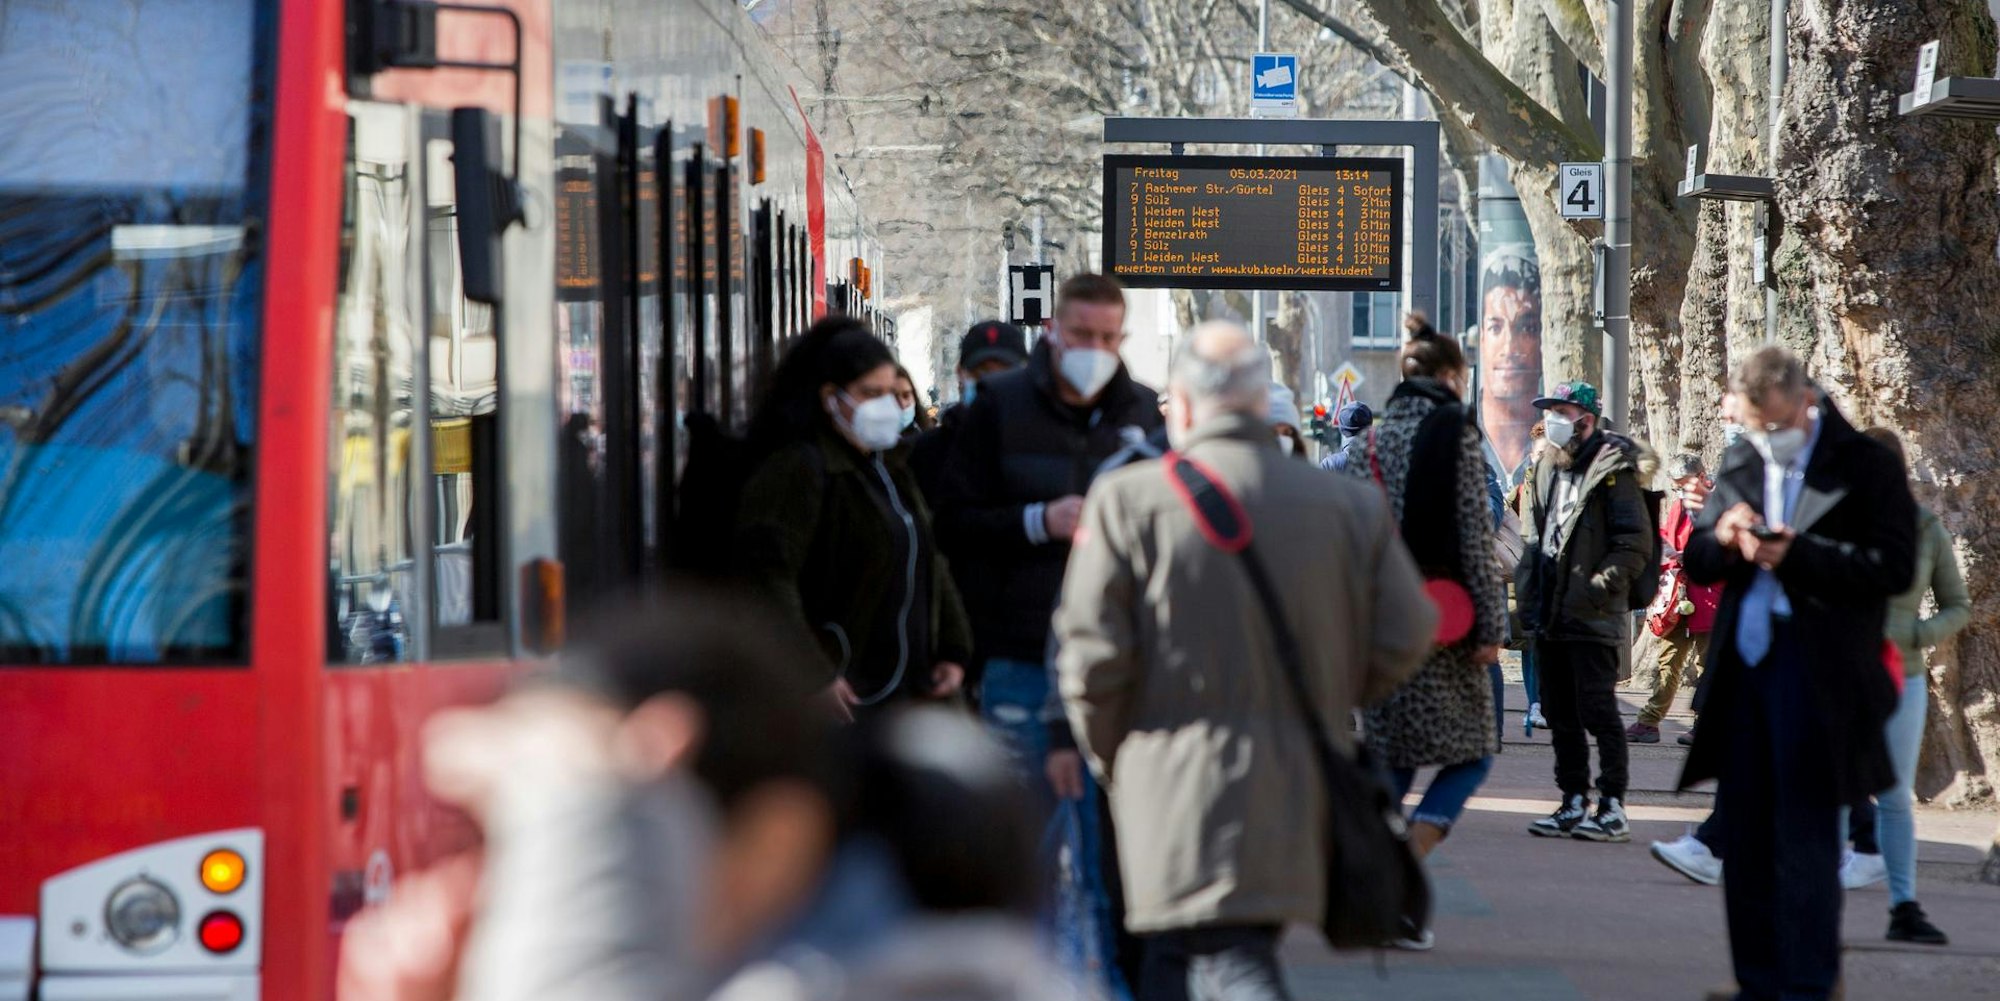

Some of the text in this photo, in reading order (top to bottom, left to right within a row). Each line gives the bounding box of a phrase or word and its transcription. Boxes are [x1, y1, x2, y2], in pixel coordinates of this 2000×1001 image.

[1134, 167, 1369, 180] Freitag 05.03.2021 13:14
[1569, 168, 1593, 176] Gleis
[1131, 182, 1138, 192] 7
[1145, 182, 1198, 194] Aachener
[1298, 185, 1330, 196] Gleis
[1336, 186, 1344, 196] 4
[1354, 185, 1392, 198] Sofort
[1567, 180, 1595, 212] 4
[1130, 194, 1138, 204] 9
[1298, 196, 1330, 206] Gleis
[1336, 197, 1344, 207] 4
[1131, 206, 1137, 216] 1
[1144, 206, 1185, 217] Weiden
[1192, 206, 1220, 217] West
[1298, 208, 1330, 218] Gleis
[1336, 208, 1344, 218] 4
[1131, 218, 1137, 227] 1
[1144, 218, 1185, 228] Weiden
[1192, 218, 1220, 228] West
[1298, 220, 1330, 230] Gleis
[1336, 220, 1344, 230] 4
[1130, 228, 1138, 238] 7
[1144, 229, 1208, 240] Benzelrath
[1298, 230, 1330, 242] Gleis
[1336, 232, 1344, 242] 4
[1130, 240, 1138, 250] 9
[1298, 242, 1329, 252] Gleis
[1336, 242, 1344, 252] 4
[1131, 252, 1137, 262] 1
[1144, 252, 1184, 262] Weiden
[1192, 252, 1220, 262] West
[1298, 254, 1329, 264] Gleis
[1336, 254, 1344, 264] 4
[1172, 263, 1204, 274] unter
[1011, 272, 1052, 320] H
